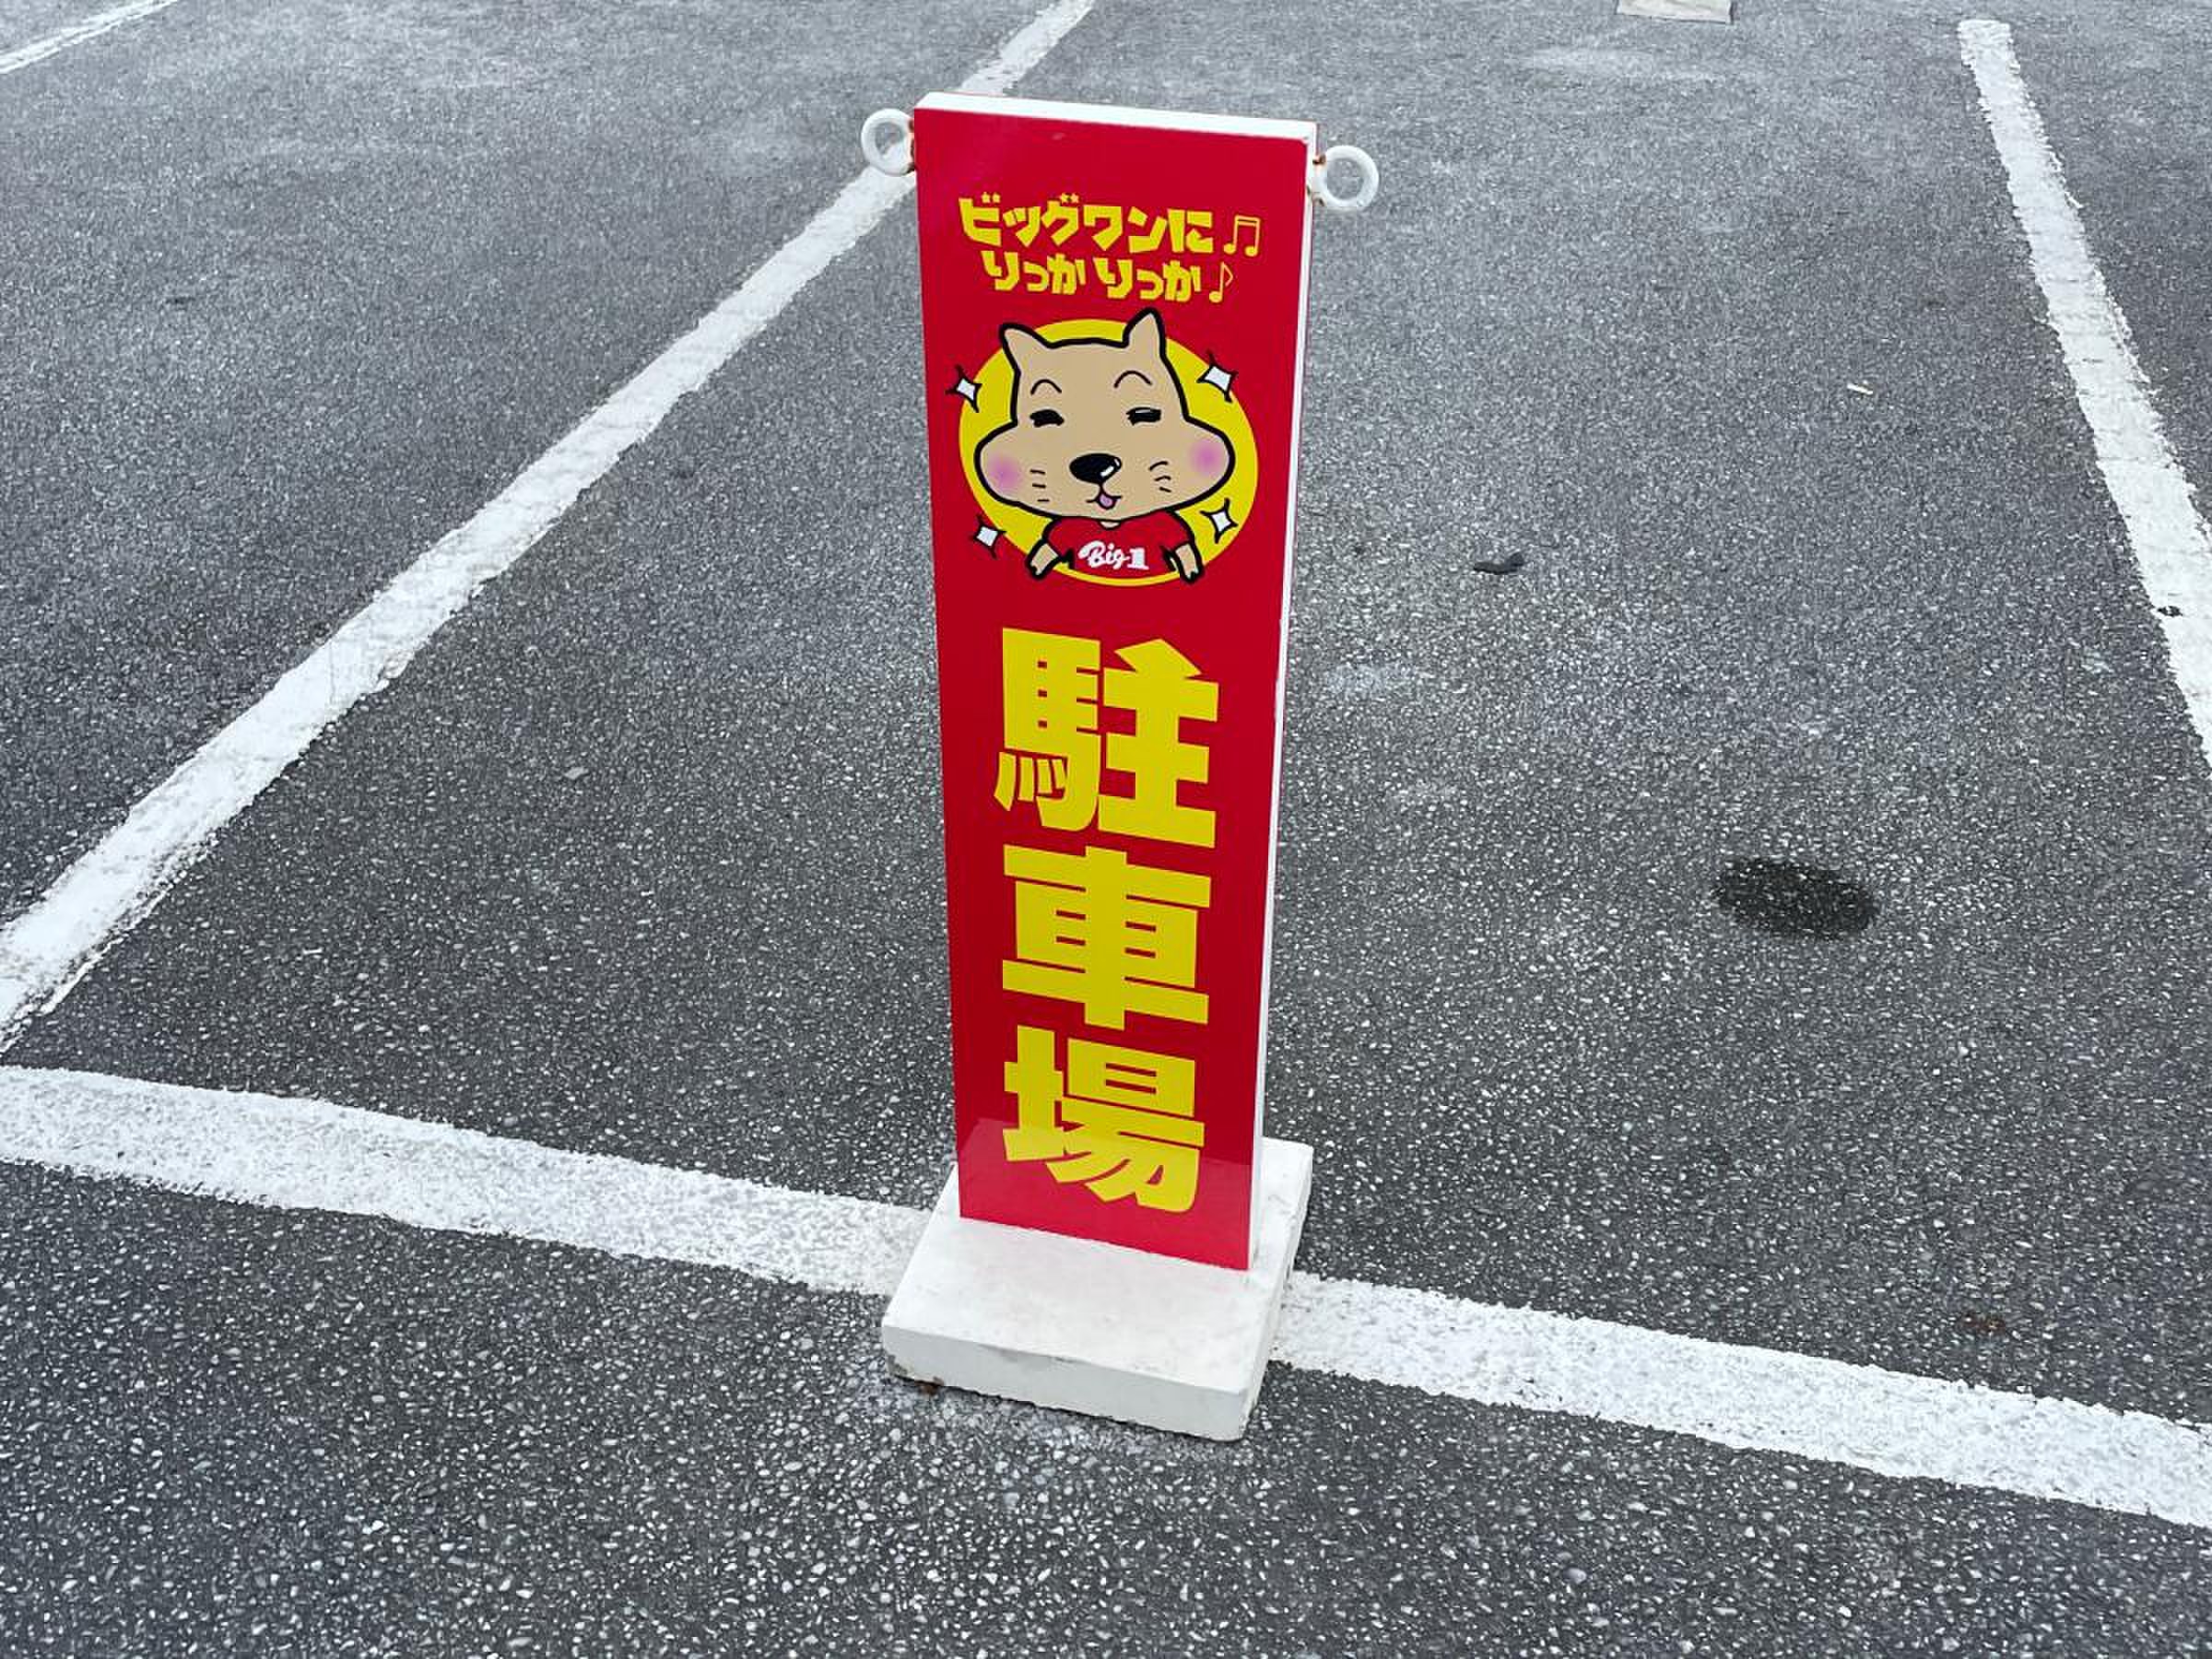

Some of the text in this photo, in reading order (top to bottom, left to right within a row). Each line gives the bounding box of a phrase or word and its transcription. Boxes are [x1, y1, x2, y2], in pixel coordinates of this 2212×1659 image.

[958, 191, 1214, 253] ビッグワンに
[981, 250, 1202, 302] りっか りっか
[994, 627, 1219, 1213] 駐車場
